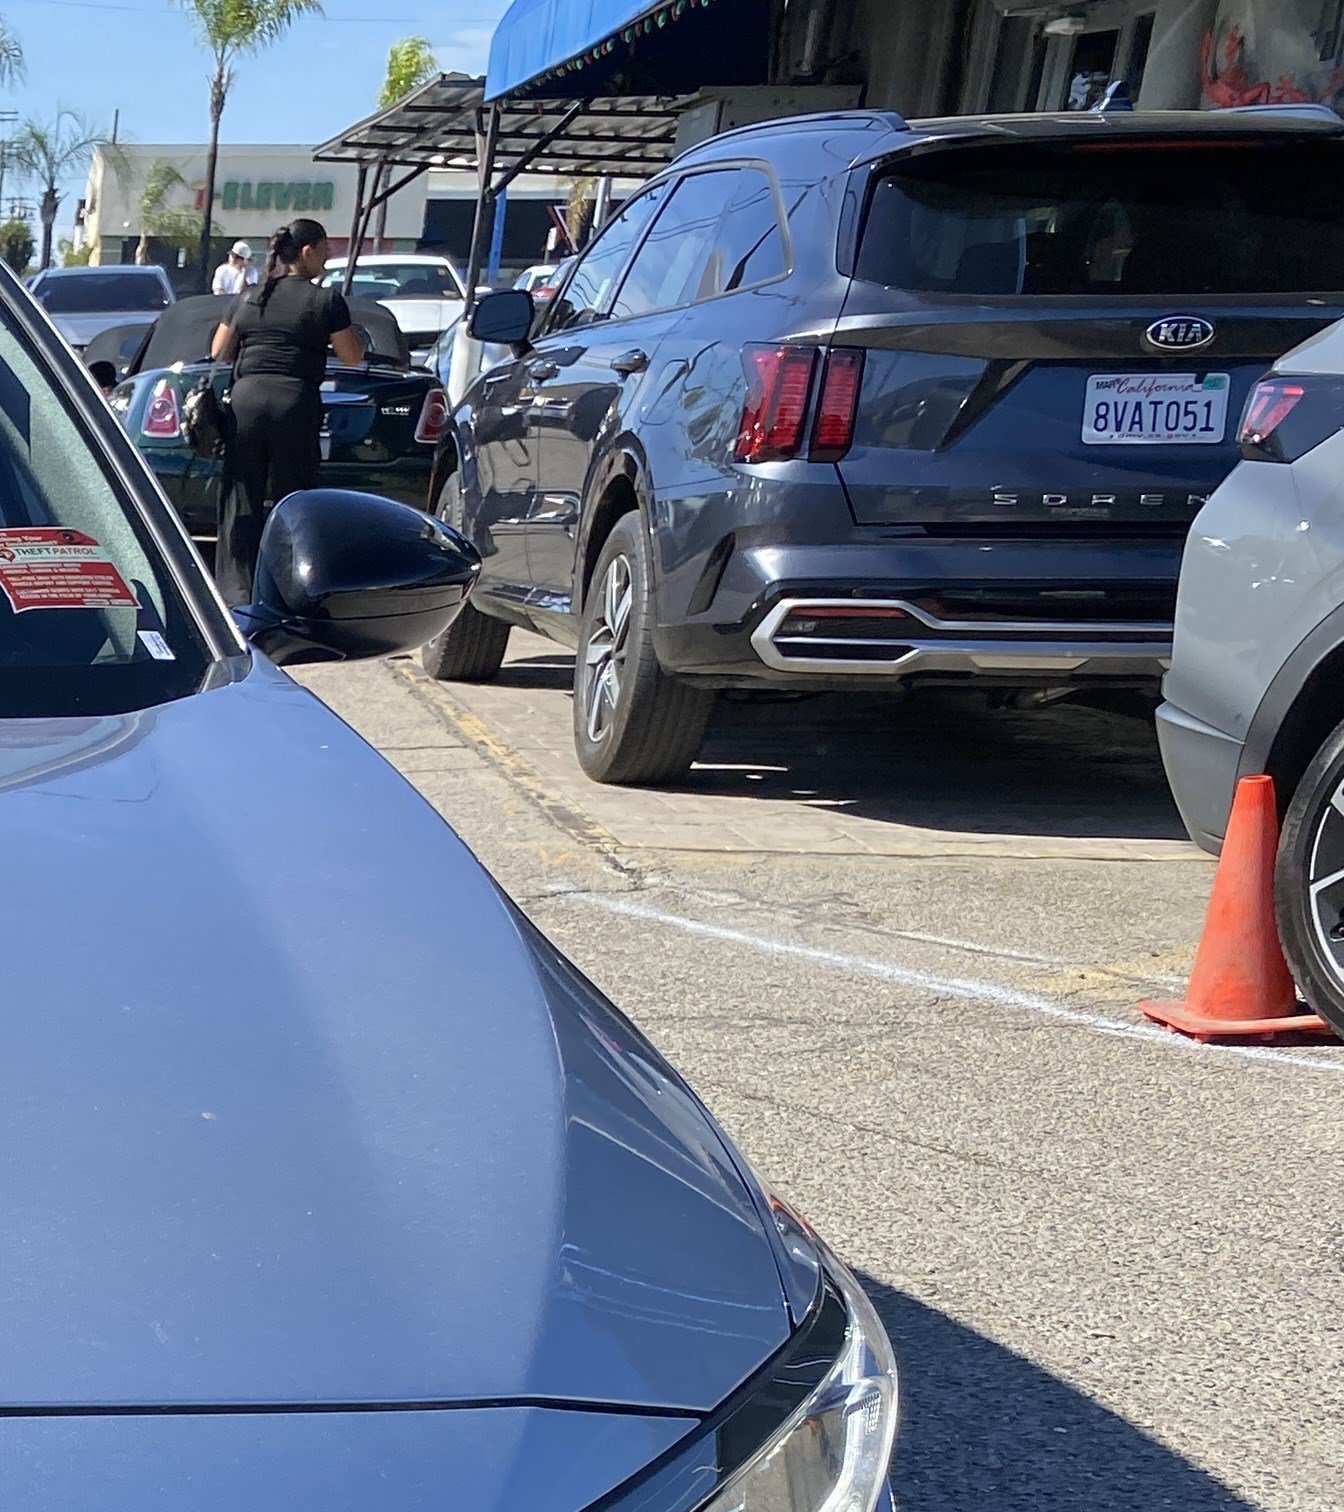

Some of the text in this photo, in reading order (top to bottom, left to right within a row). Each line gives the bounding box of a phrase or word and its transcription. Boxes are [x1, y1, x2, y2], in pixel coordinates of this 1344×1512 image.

[1158, 323, 1204, 343] KIA
[1116, 377, 1203, 399] California
[1093, 400, 1215, 433] 8VAT051
